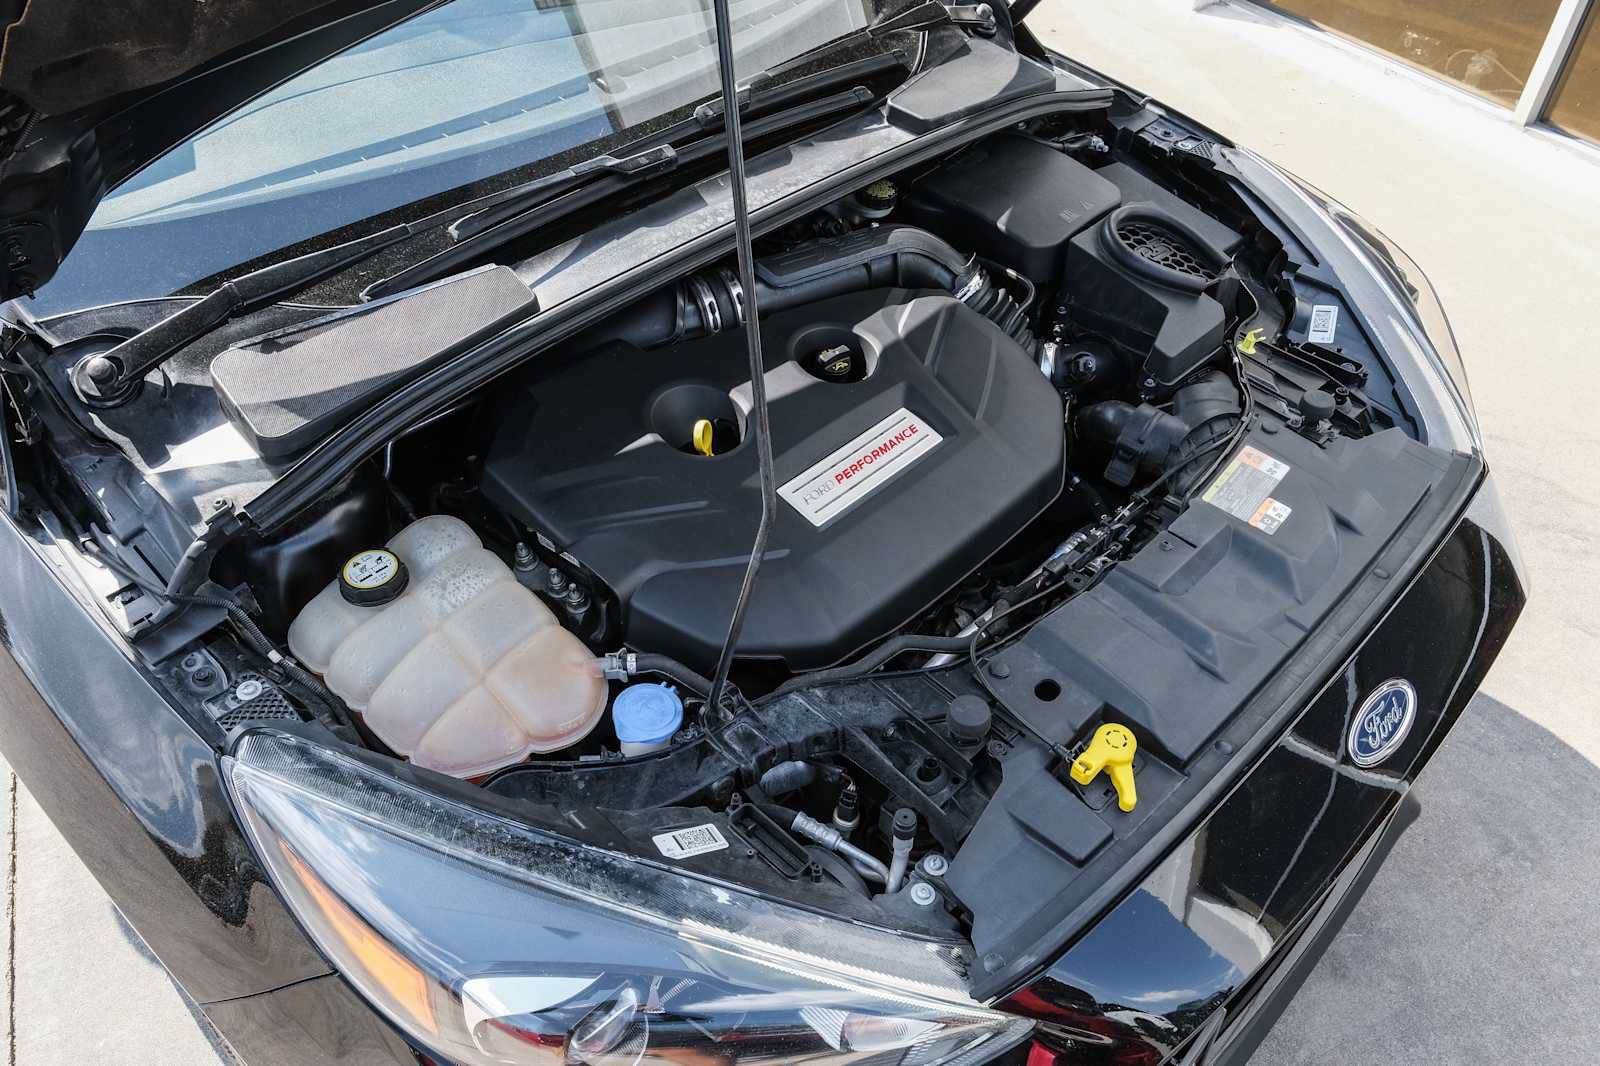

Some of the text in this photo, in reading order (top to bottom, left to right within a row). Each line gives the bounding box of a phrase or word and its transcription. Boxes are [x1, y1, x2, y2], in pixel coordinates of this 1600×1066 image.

[803, 424, 919, 505] FORD PERFORMANCE
[1365, 697, 1402, 749] Ford
